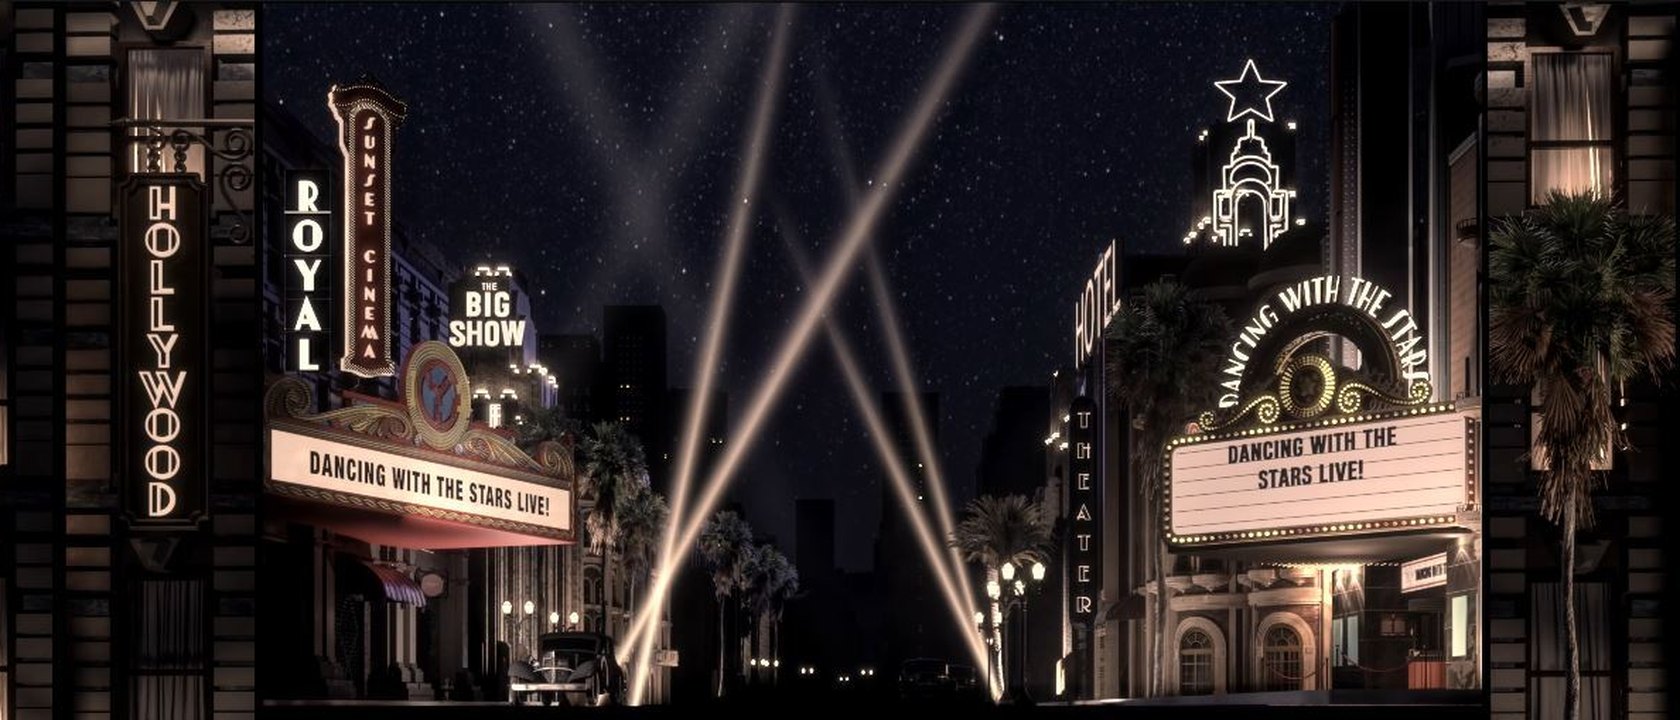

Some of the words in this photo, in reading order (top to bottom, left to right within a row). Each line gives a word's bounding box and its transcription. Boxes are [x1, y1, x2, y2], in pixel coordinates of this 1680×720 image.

[363, 116, 376, 226] SUNSET
[292, 180, 323, 371] ROYAL
[361, 249, 379, 359] CINEMA
[466, 291, 510, 318] BIG
[481, 282, 498, 291] THE
[1075, 238, 1121, 368] HOTEL
[138, 185, 187, 517] HOLLYWOOD
[449, 320, 526, 347] SHOW
[1219, 304, 1279, 409] DANCING
[1278, 275, 1340, 312] WITH
[1347, 276, 1392, 318] THE
[1381, 308, 1430, 381] STARS
[309, 450, 386, 487] DANCING
[392, 466, 431, 496] WITH
[436, 476, 464, 501] THE
[469, 482, 513, 510] STARS
[517, 491, 550, 516] LIVE!
[1228, 437, 1303, 464] DANCING
[1309, 431, 1355, 455] WITH
[1362, 426, 1397, 448] THE
[1258, 464, 1313, 490] STARS
[1318, 459, 1364, 484] LIVE!
[1076, 411, 1092, 614] THEATER
